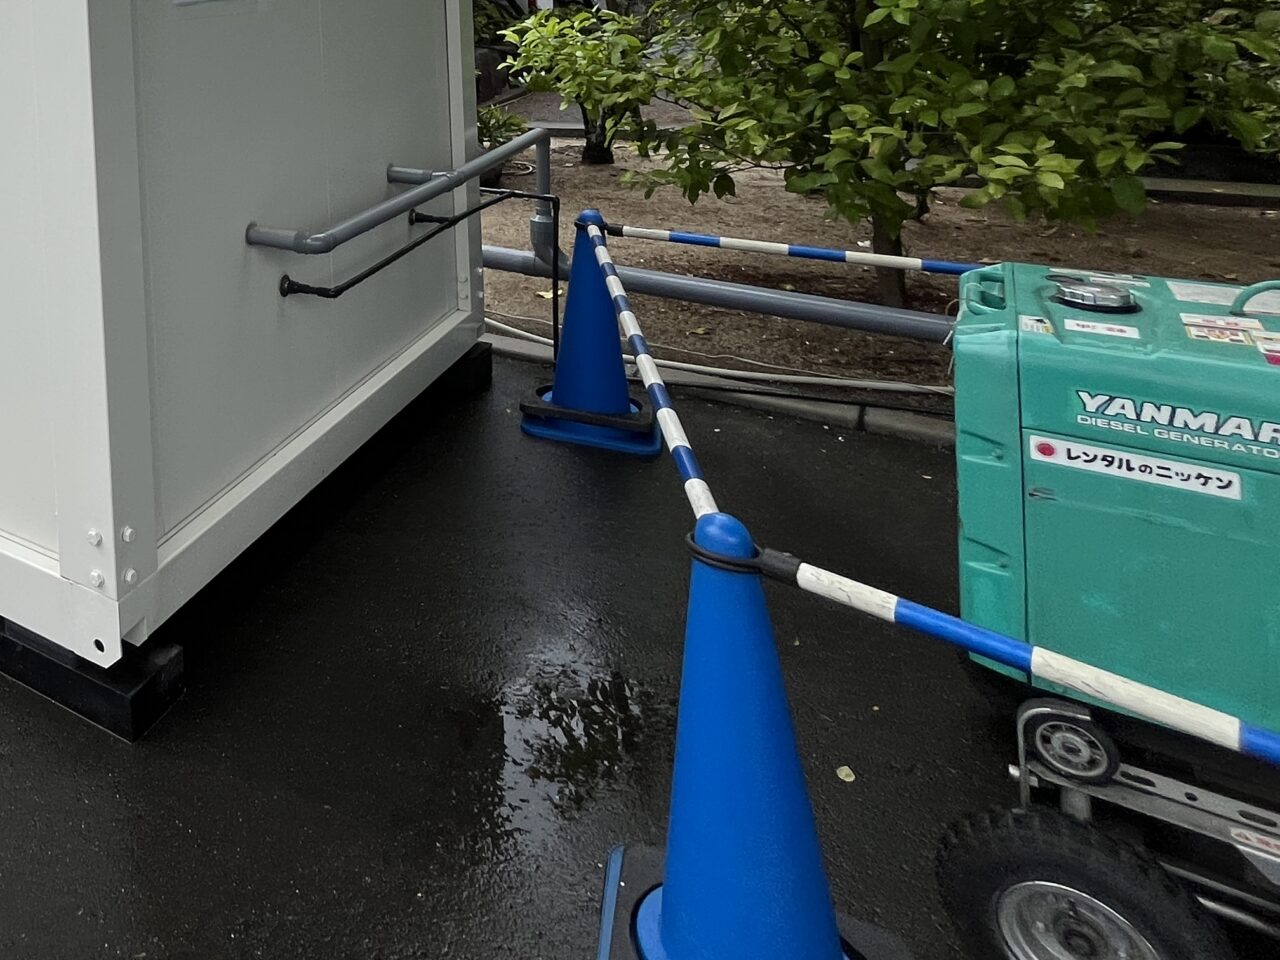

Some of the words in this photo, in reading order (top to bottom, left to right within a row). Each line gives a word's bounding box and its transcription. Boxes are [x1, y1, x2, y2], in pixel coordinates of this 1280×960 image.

[1077, 415, 1150, 435] DIESEL
[1153, 428, 1280, 459] GENERATO
[1066, 447, 1233, 490] レンタルのニッケン
